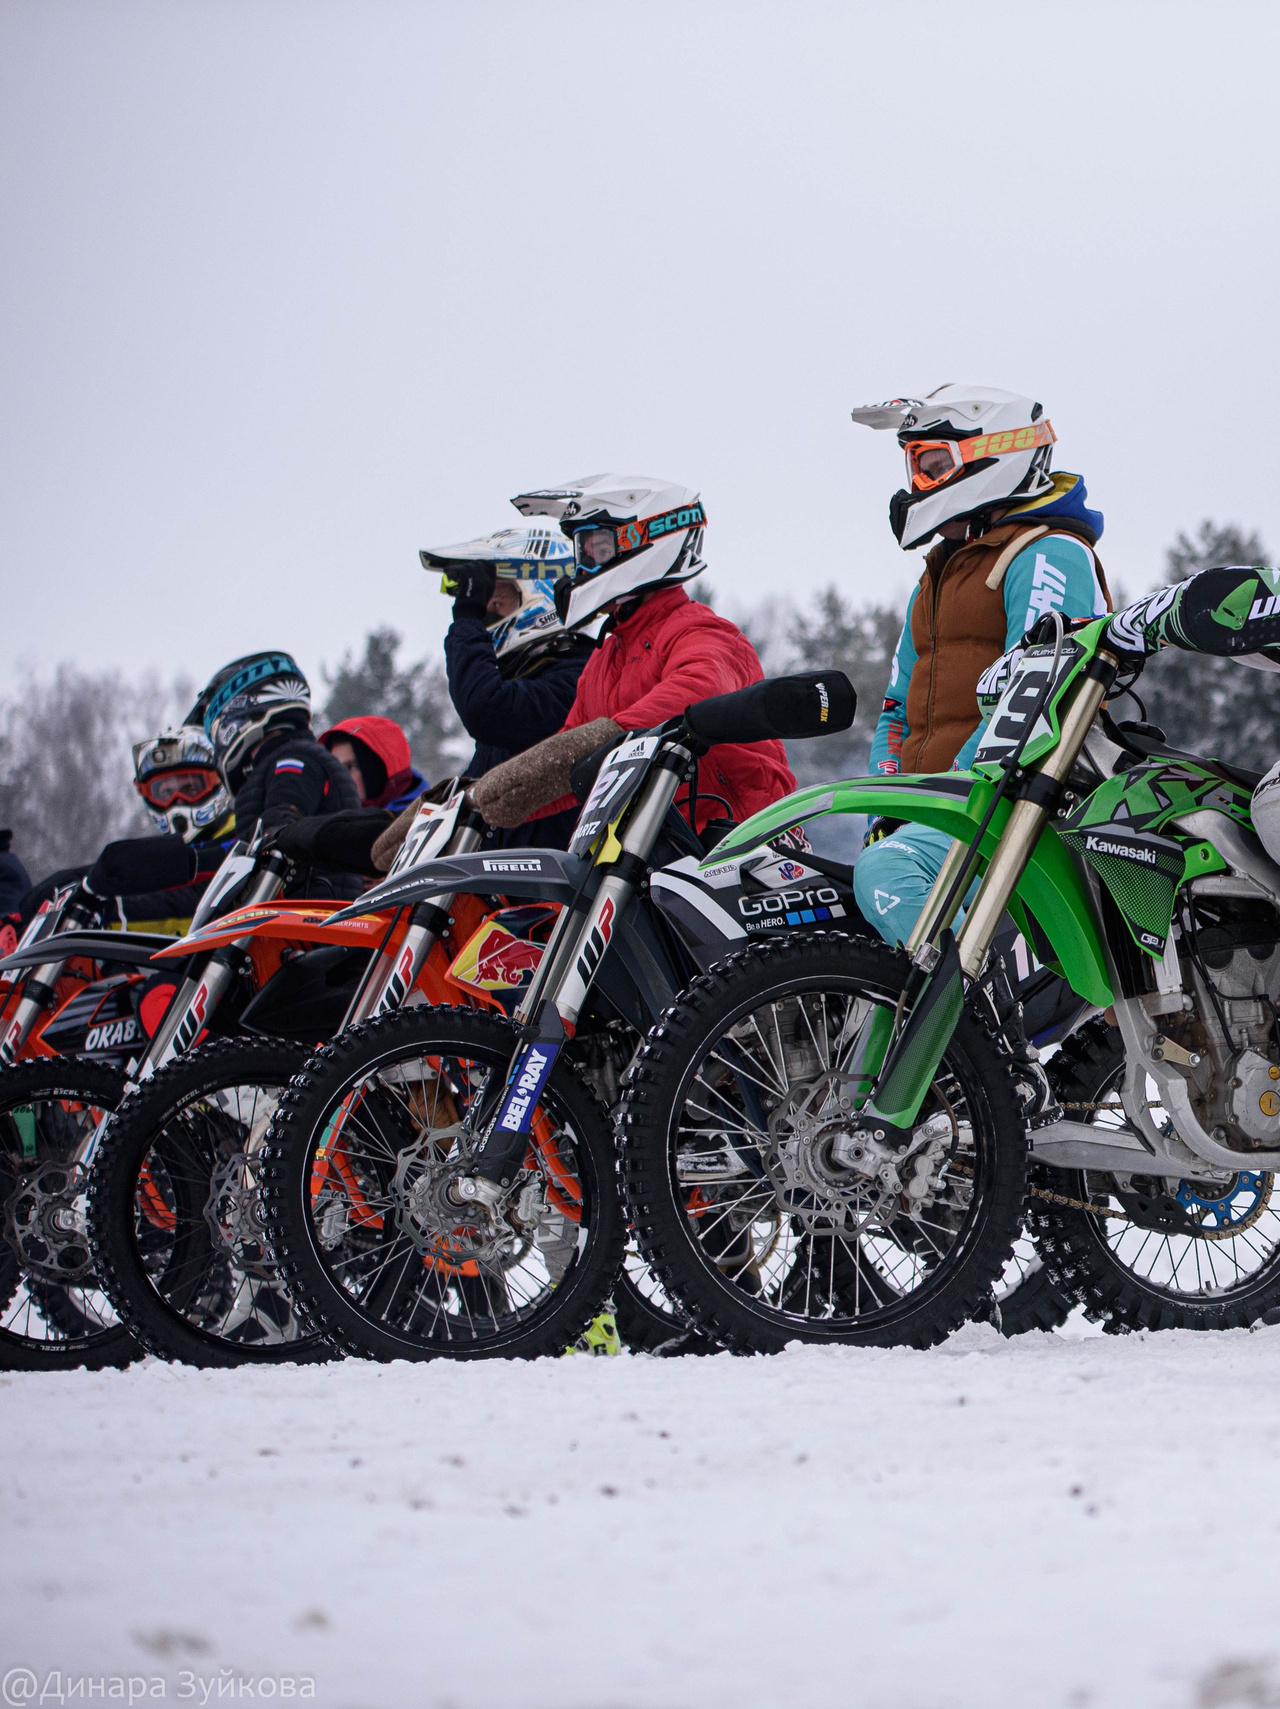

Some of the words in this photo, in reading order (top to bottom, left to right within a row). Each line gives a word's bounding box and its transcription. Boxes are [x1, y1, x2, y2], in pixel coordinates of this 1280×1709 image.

[970, 424, 1054, 459] 100%
[496, 562, 576, 580] Ethe
[1085, 836, 1157, 864] Kawasaki
[482, 858, 542, 872] PIRELLI
[738, 887, 839, 917] GoPro
[85, 1020, 140, 1052] OKAB
